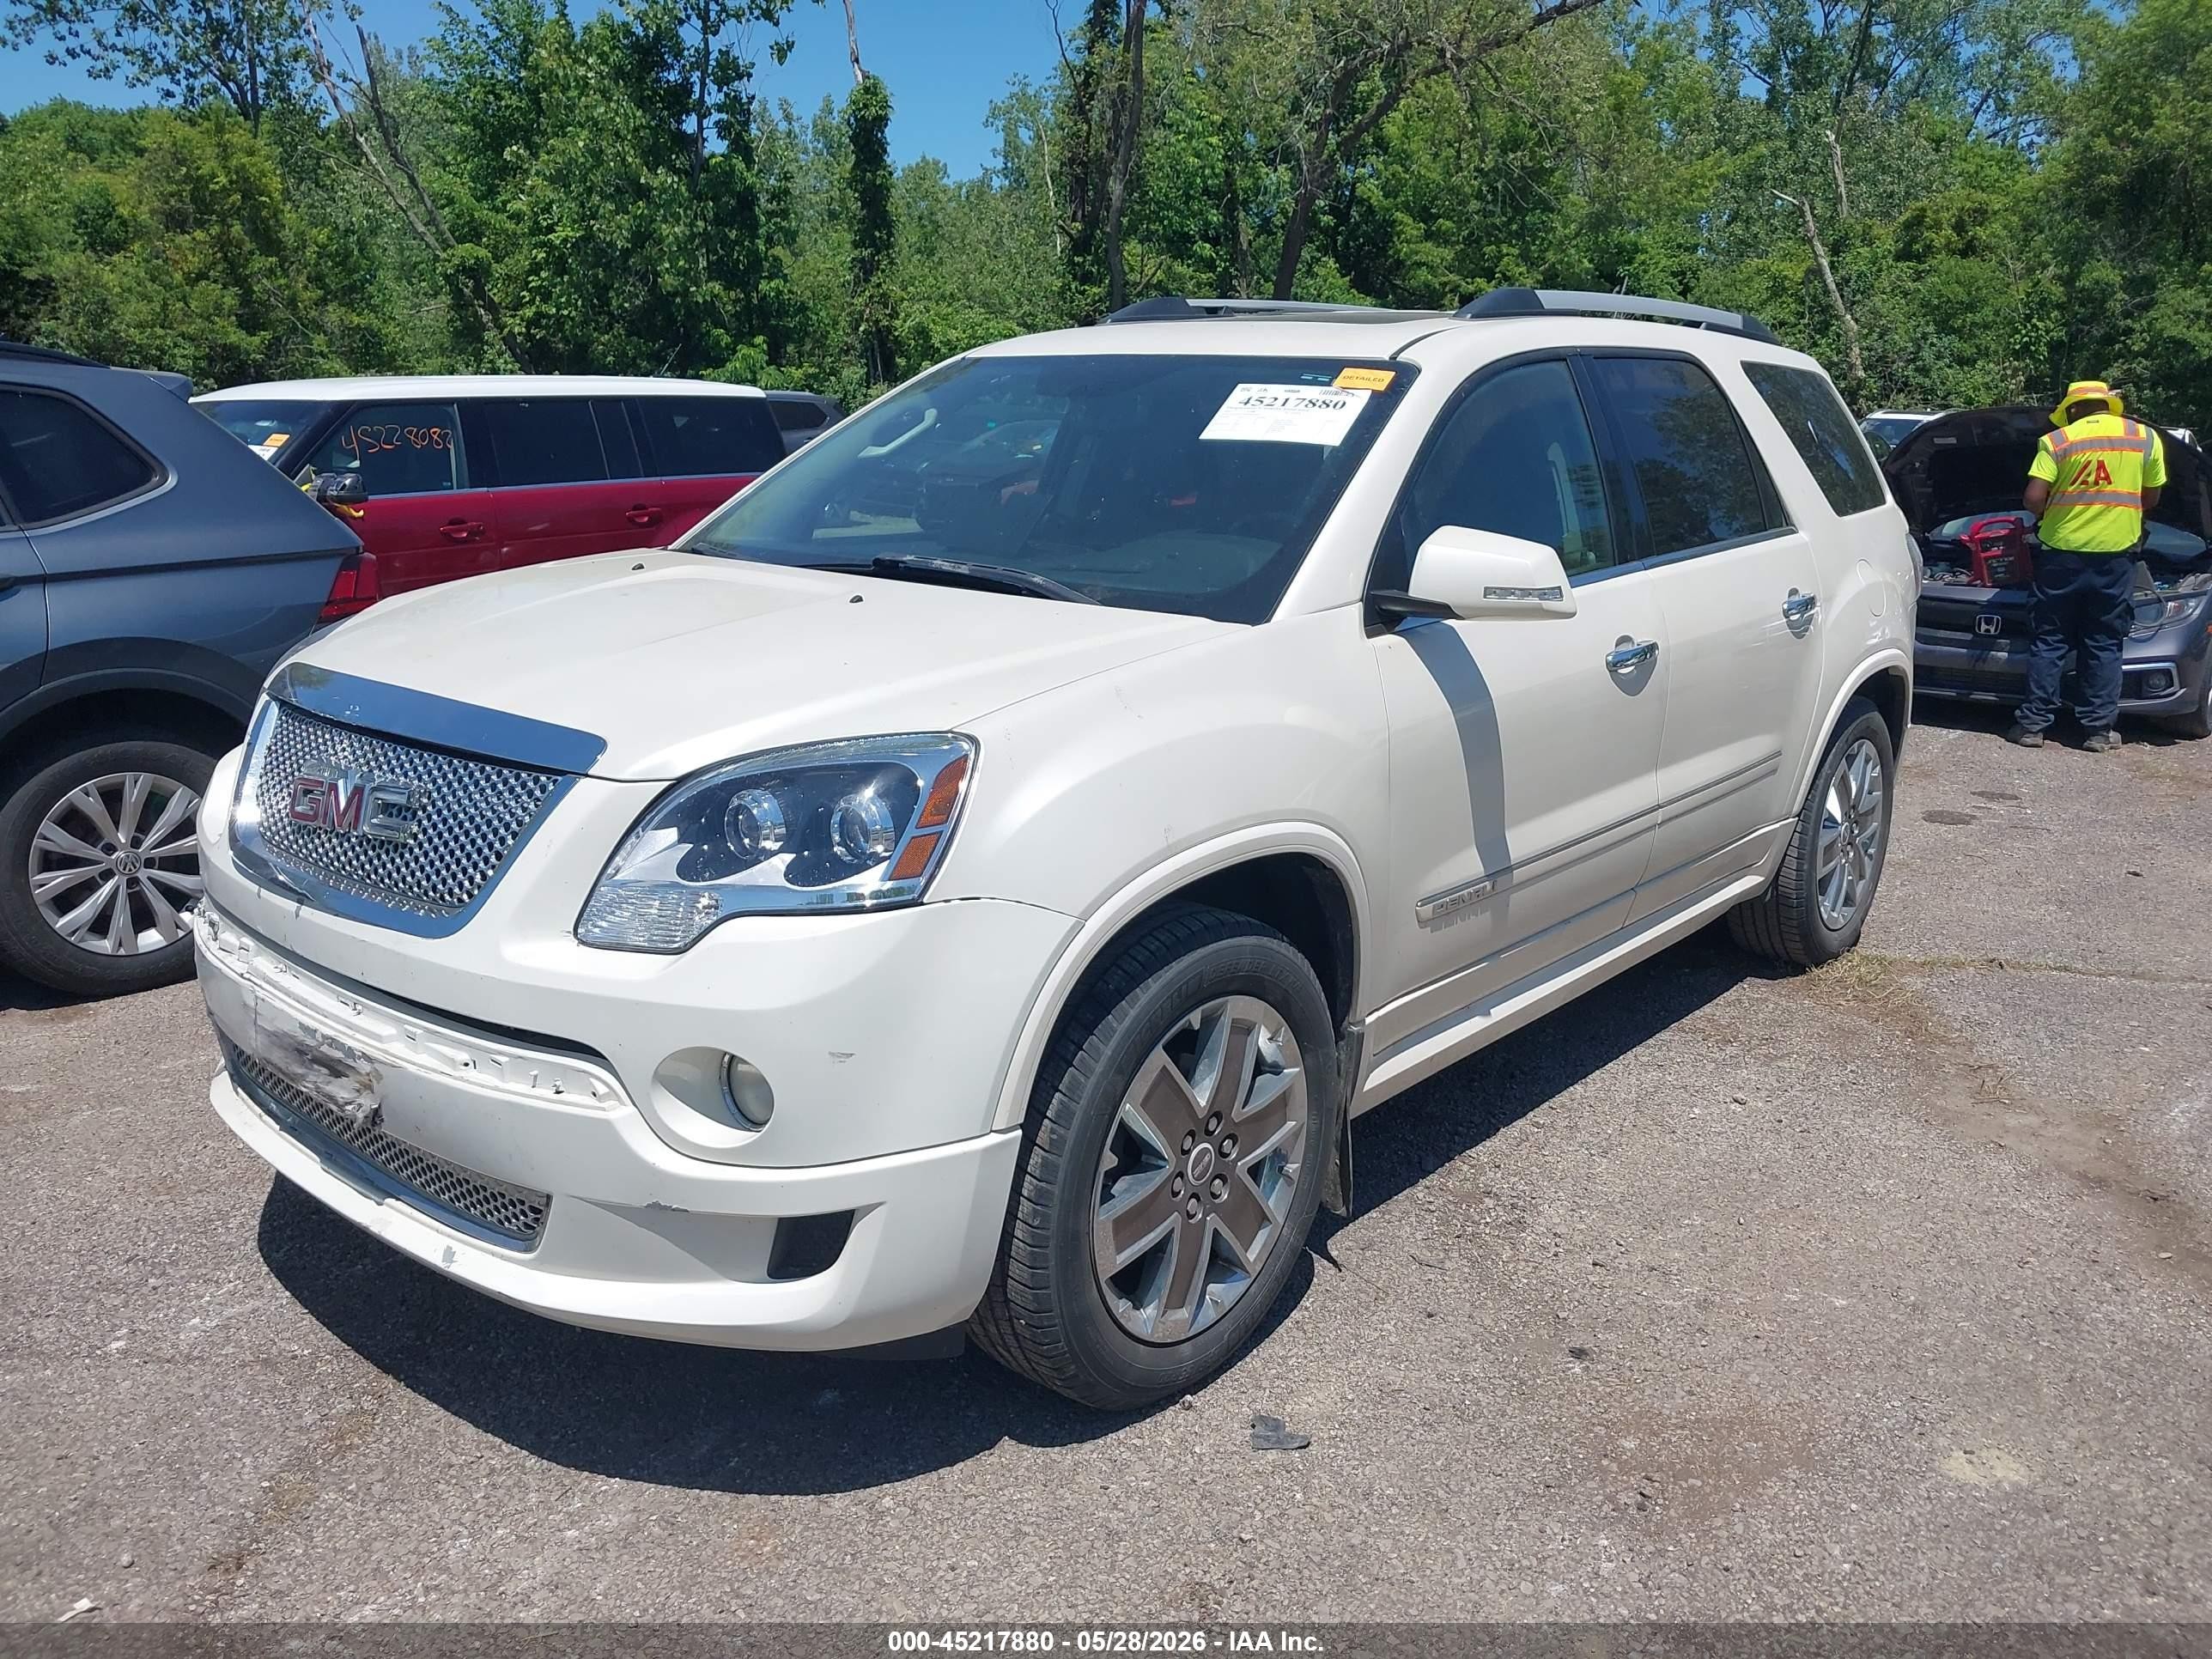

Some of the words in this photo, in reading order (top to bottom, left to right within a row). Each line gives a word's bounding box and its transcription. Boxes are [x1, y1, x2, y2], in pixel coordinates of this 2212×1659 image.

[1238, 396, 1346, 410] 45217880
[289, 774, 412, 841] GMC
[1434, 878, 1498, 913] DENALI
